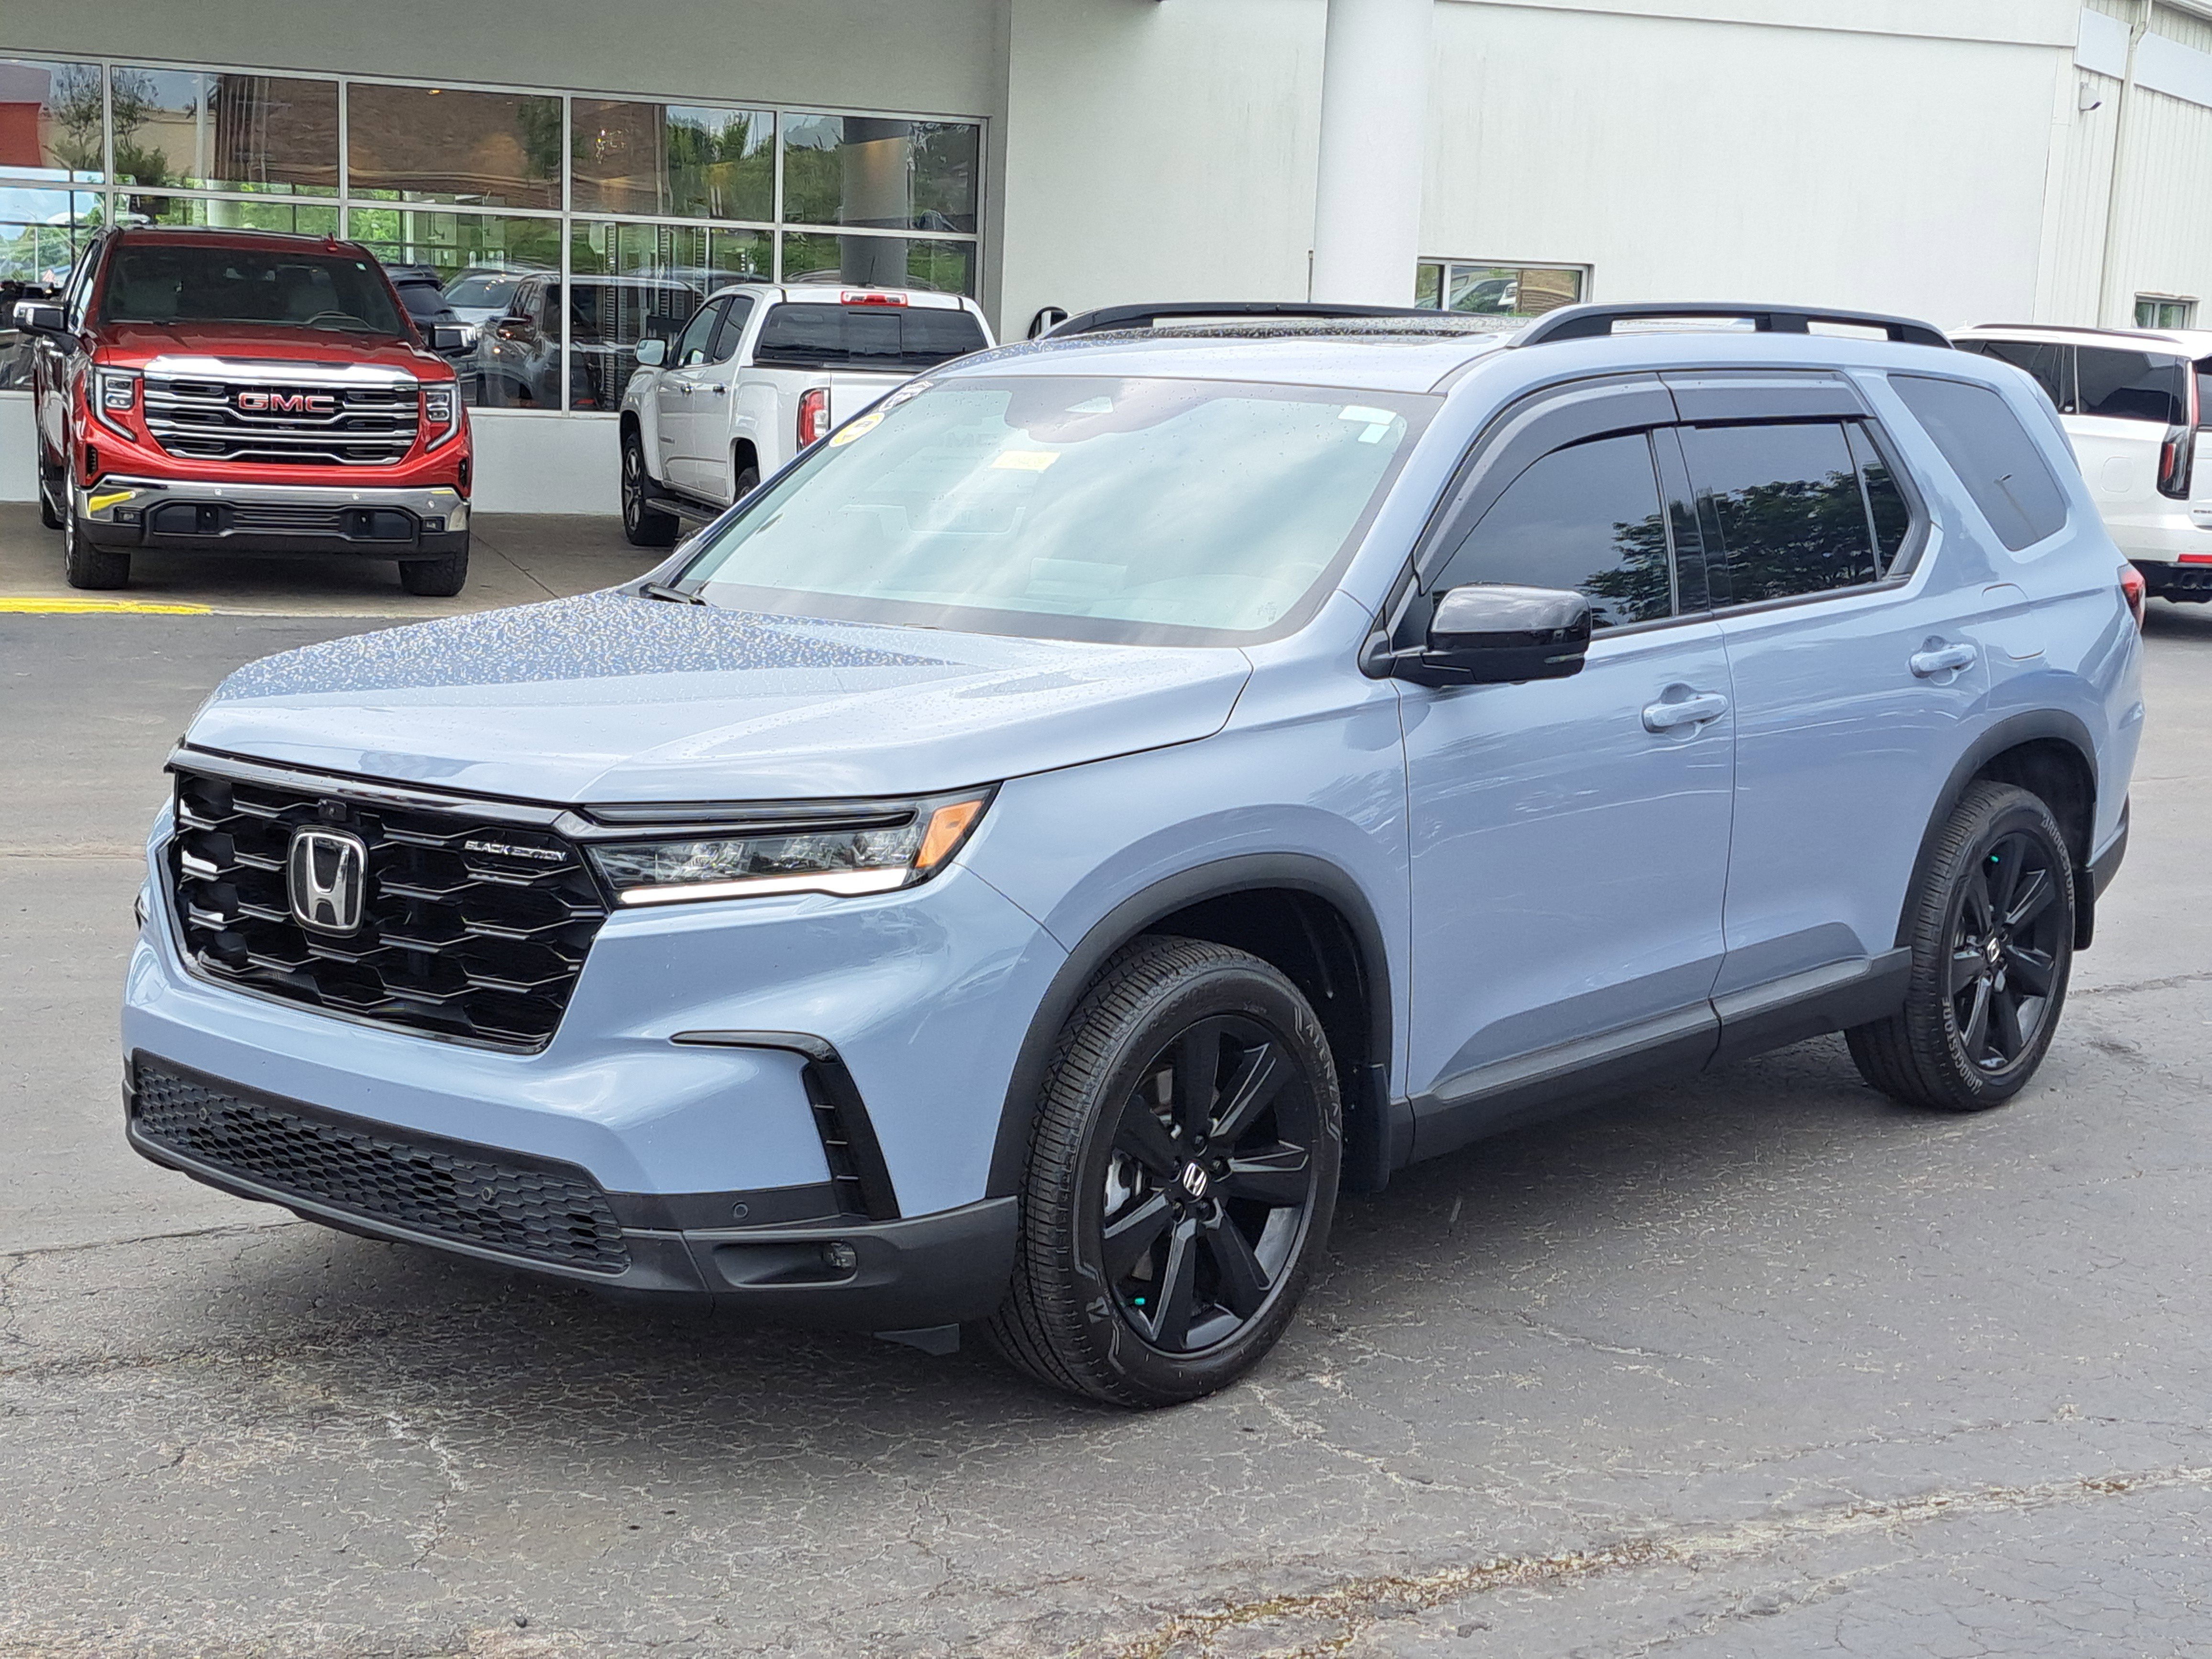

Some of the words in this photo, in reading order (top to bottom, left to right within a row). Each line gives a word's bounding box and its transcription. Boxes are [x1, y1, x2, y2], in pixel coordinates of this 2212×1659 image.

[238, 392, 335, 414] GMC
[465, 840, 511, 855] BLACK
[1942, 996, 1983, 1096] BRIDGESTONE
